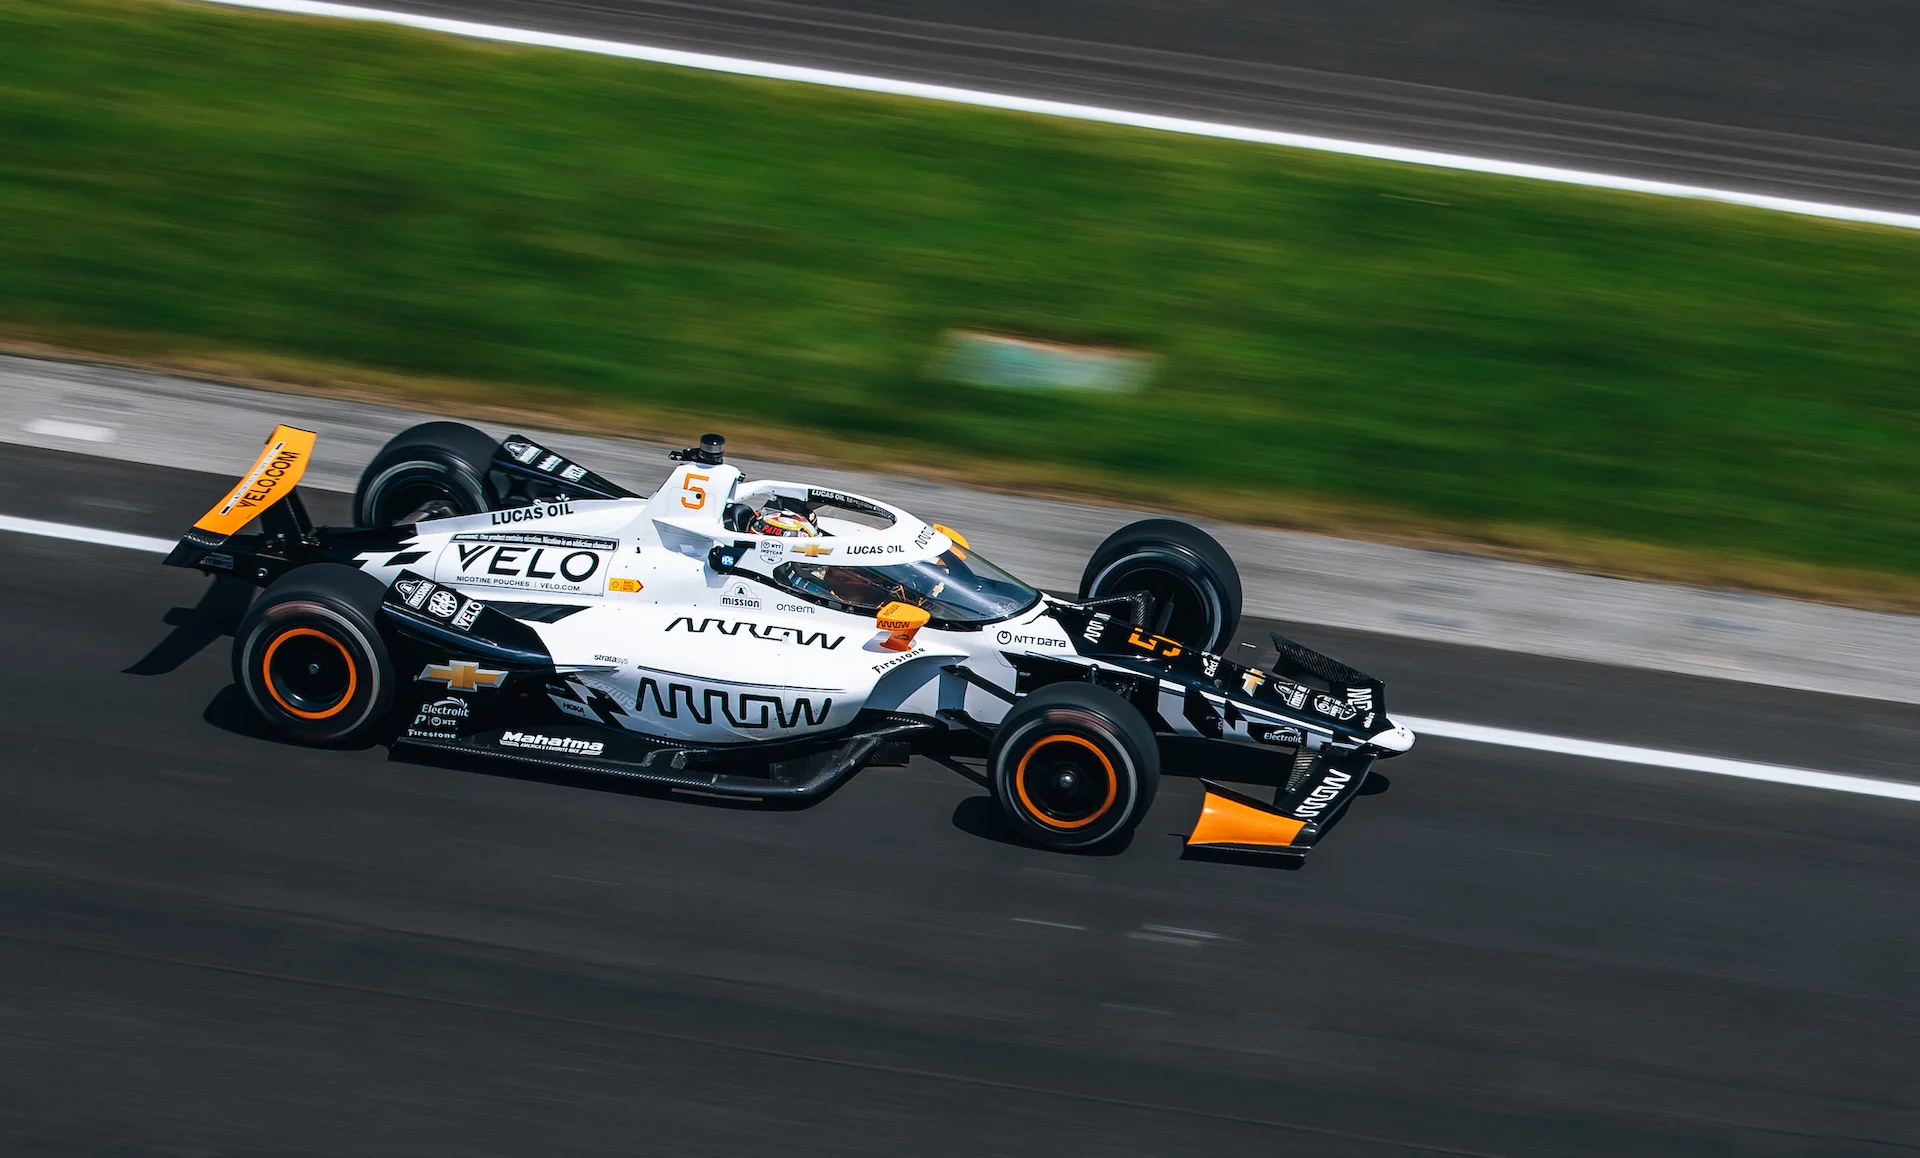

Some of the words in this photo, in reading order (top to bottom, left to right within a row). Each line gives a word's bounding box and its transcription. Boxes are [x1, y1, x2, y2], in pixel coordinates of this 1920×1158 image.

[236, 451, 300, 508] VELO.COM
[680, 473, 709, 510] 5
[811, 489, 834, 499] LUCAS
[491, 505, 543, 525] LUCAS
[547, 503, 574, 517] OIL
[846, 546, 884, 554] LUCAS
[886, 545, 905, 553] OIL
[458, 544, 600, 582] VELO
[456, 575, 491, 584] NICOTINE
[493, 579, 530, 587] POUCHES
[540, 583, 580, 591] VELO.COM
[457, 601, 482, 629] VELO
[776, 603, 815, 614] onsemi
[877, 620, 910, 629] ARROW
[664, 617, 846, 650] ARROW
[1014, 635, 1036, 645] NTT
[594, 654, 629, 665] stratasys
[871, 647, 926, 674] Firestone
[421, 703, 470, 717] Electrolit
[562, 702, 585, 714] HOKA
[635, 677, 832, 728] ARROW
[408, 728, 457, 739] Firestone
[502, 731, 604, 751] Mahatma
[1263, 731, 1303, 744] Electrolit
[1293, 768, 1352, 818] ARROW
